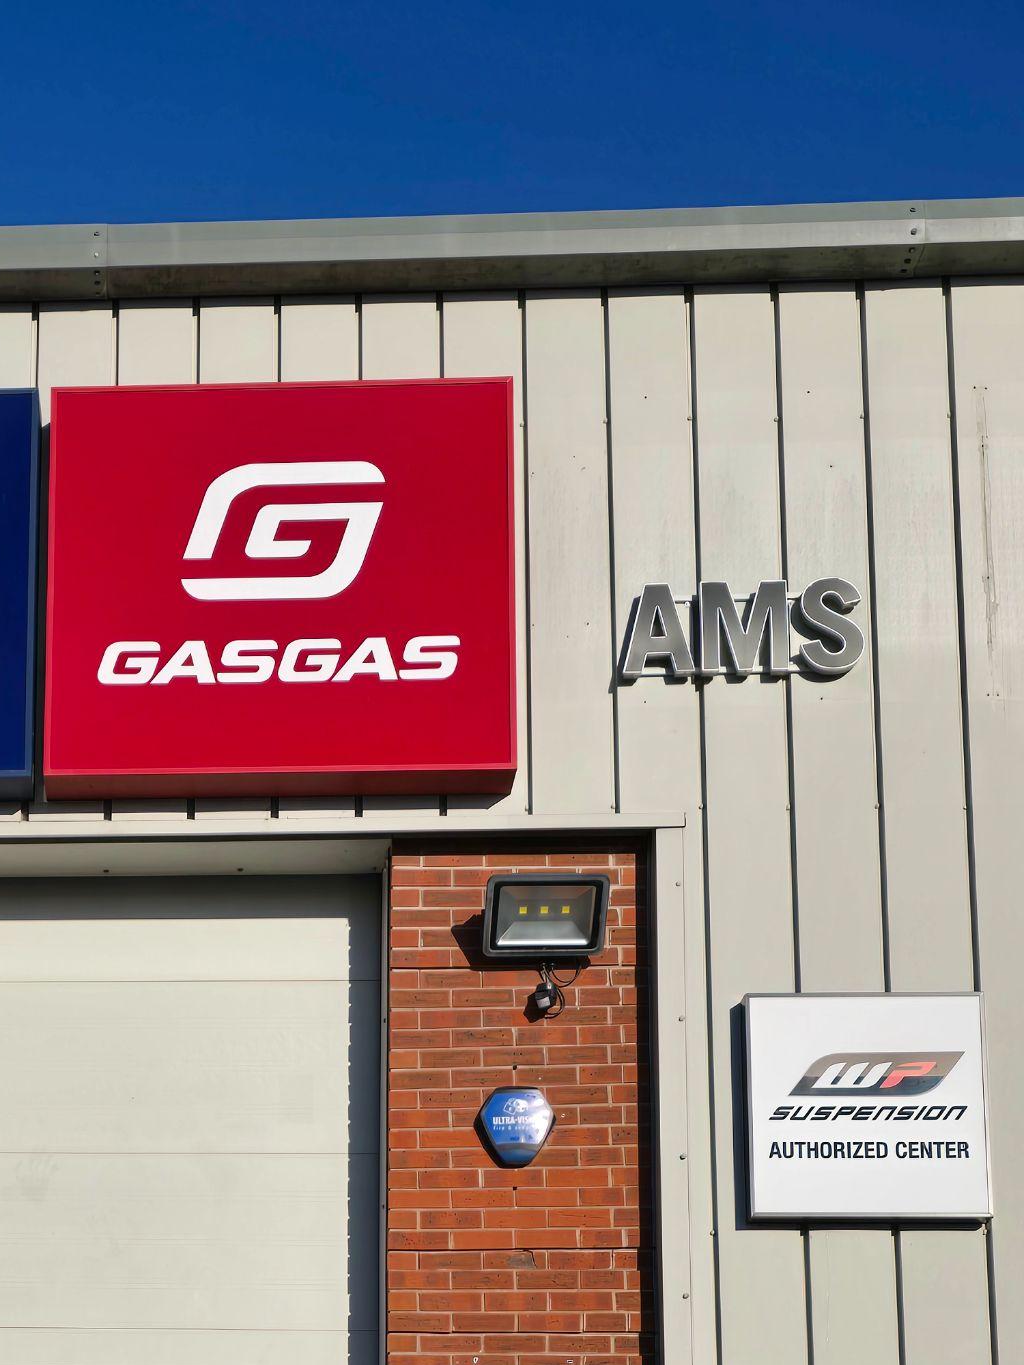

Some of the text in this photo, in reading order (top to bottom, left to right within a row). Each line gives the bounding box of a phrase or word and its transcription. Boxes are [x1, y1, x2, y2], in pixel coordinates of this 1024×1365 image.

[622, 576, 865, 677] AMS
[97, 634, 461, 685] GASGAS
[768, 1105, 969, 1121] SUSPENSION
[768, 1141, 970, 1159] AUTHORIZED CENTER
